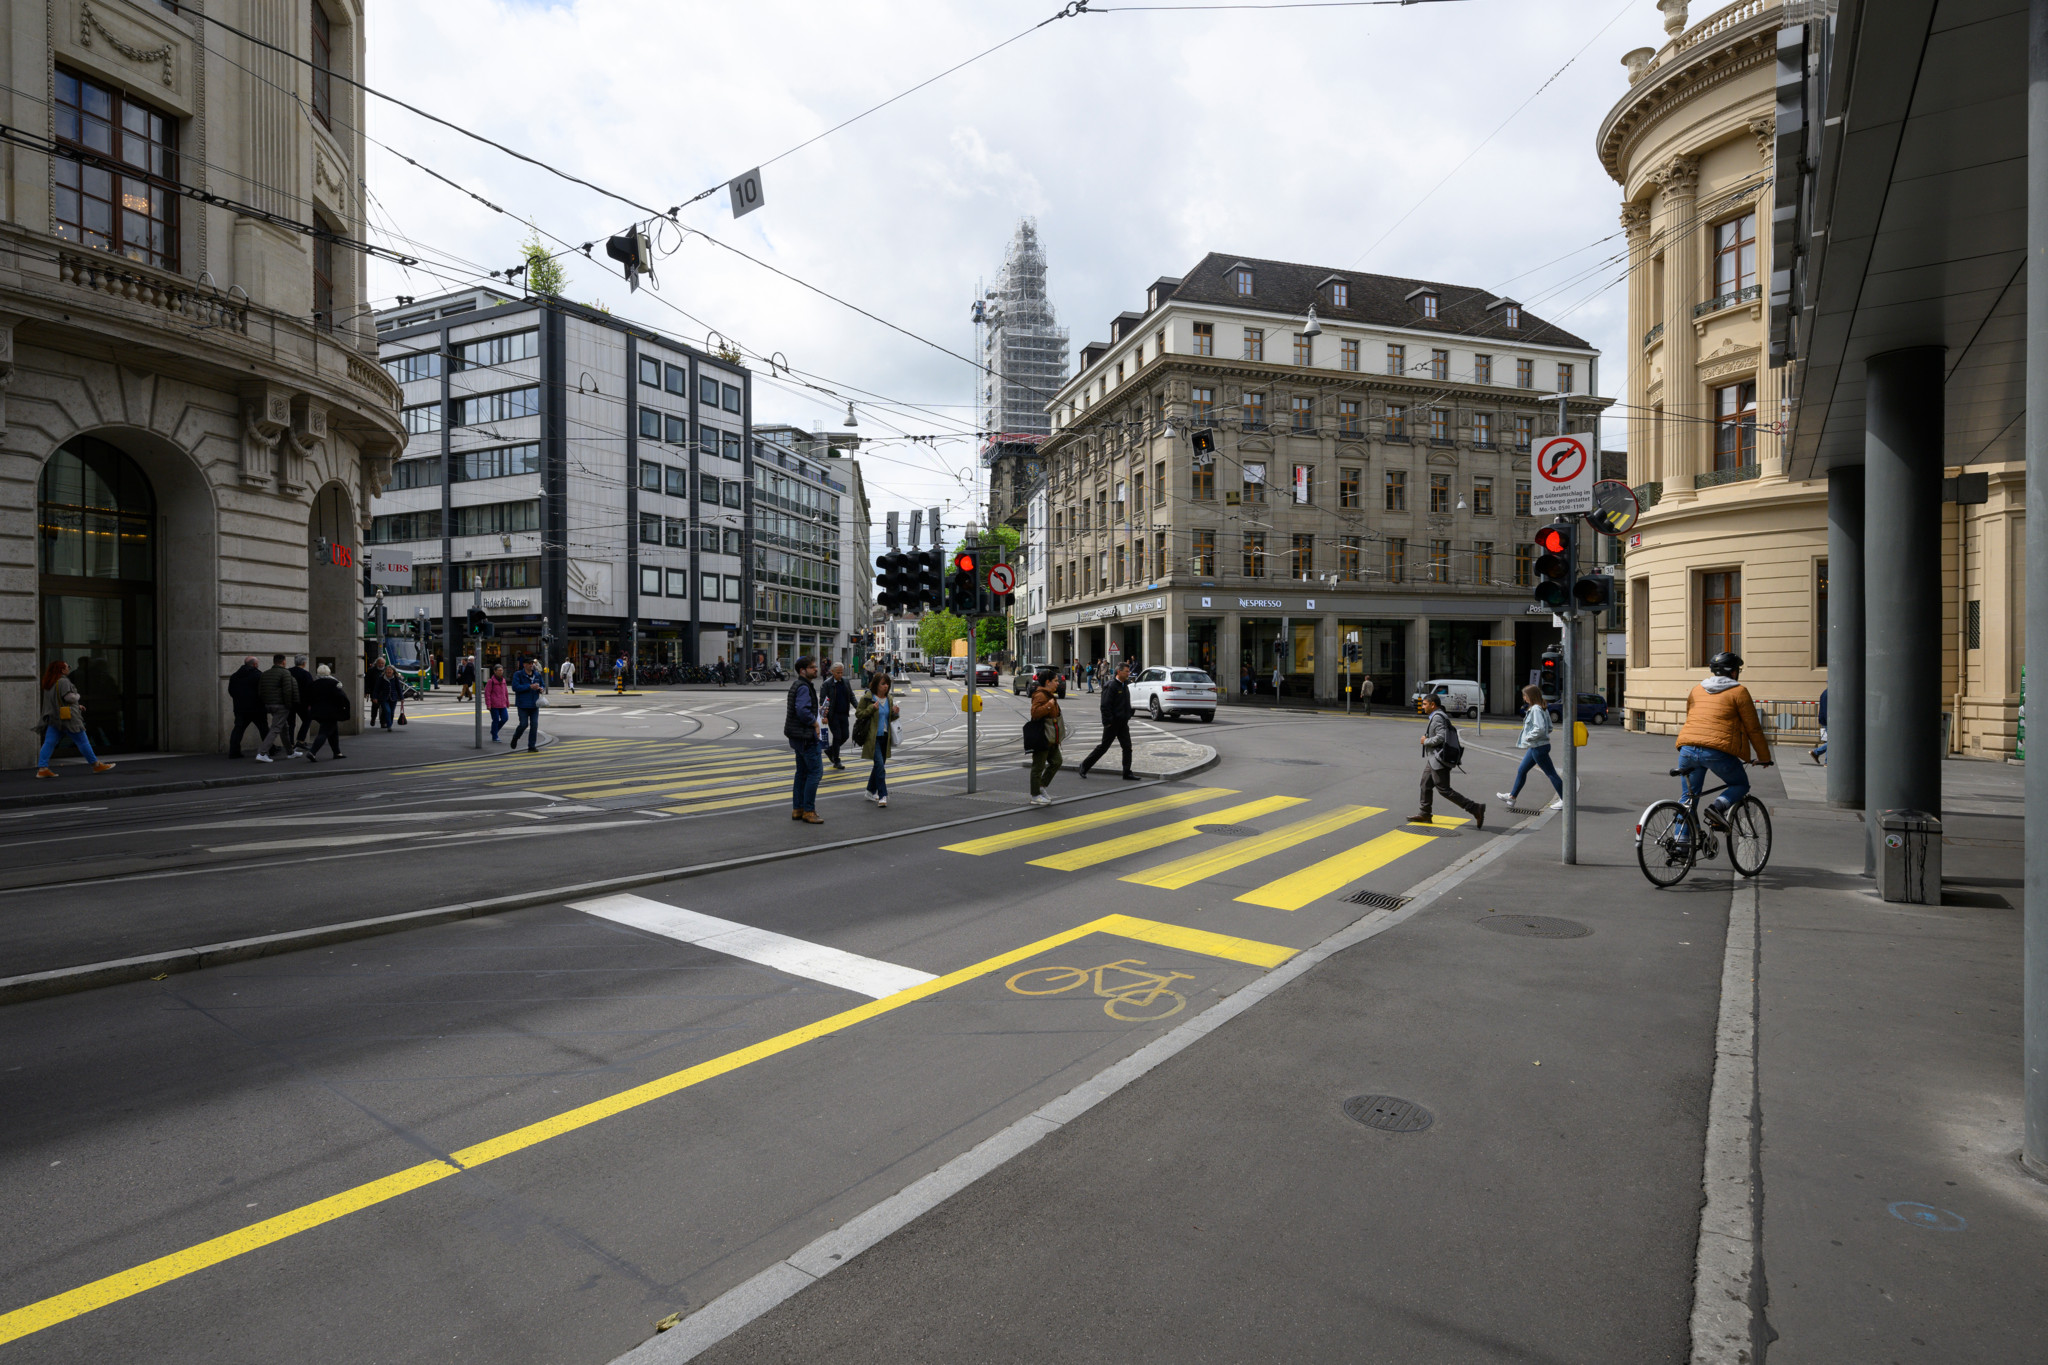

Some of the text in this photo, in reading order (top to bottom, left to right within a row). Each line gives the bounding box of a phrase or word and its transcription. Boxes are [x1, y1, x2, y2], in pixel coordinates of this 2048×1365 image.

[736, 178, 757, 208] 10
[1545, 490, 1583, 499] Güterumschlag
[1533, 496, 1590, 506] Schritttempo gestattet
[332, 543, 352, 568] UBS
[388, 563, 409, 573] UBS
[1606, 566, 1614, 575] 30
[1238, 598, 1282, 608] NESPRESSO
